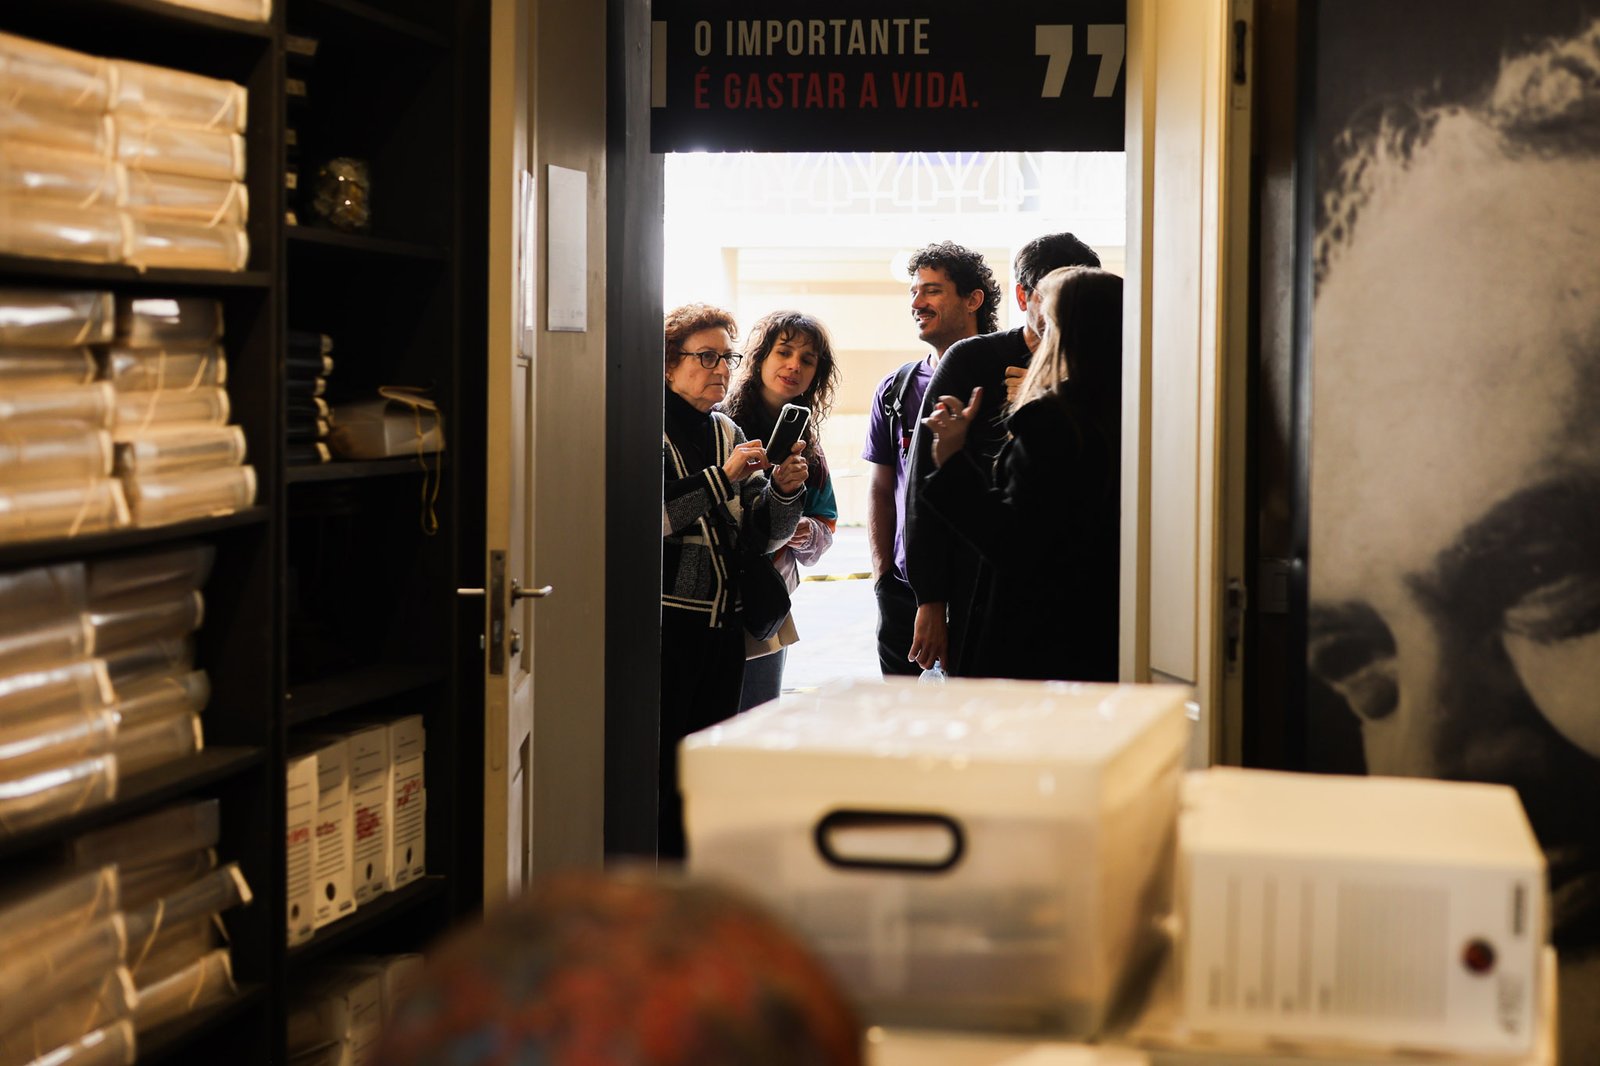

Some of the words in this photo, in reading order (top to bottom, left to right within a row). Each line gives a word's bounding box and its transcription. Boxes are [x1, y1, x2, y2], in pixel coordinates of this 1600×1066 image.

[694, 20, 712, 57] O
[725, 18, 930, 56] IMPORTANTE
[694, 67, 711, 109] É
[724, 72, 846, 109] GASTAR
[859, 72, 879, 109] A
[892, 71, 980, 109] VIDA.
